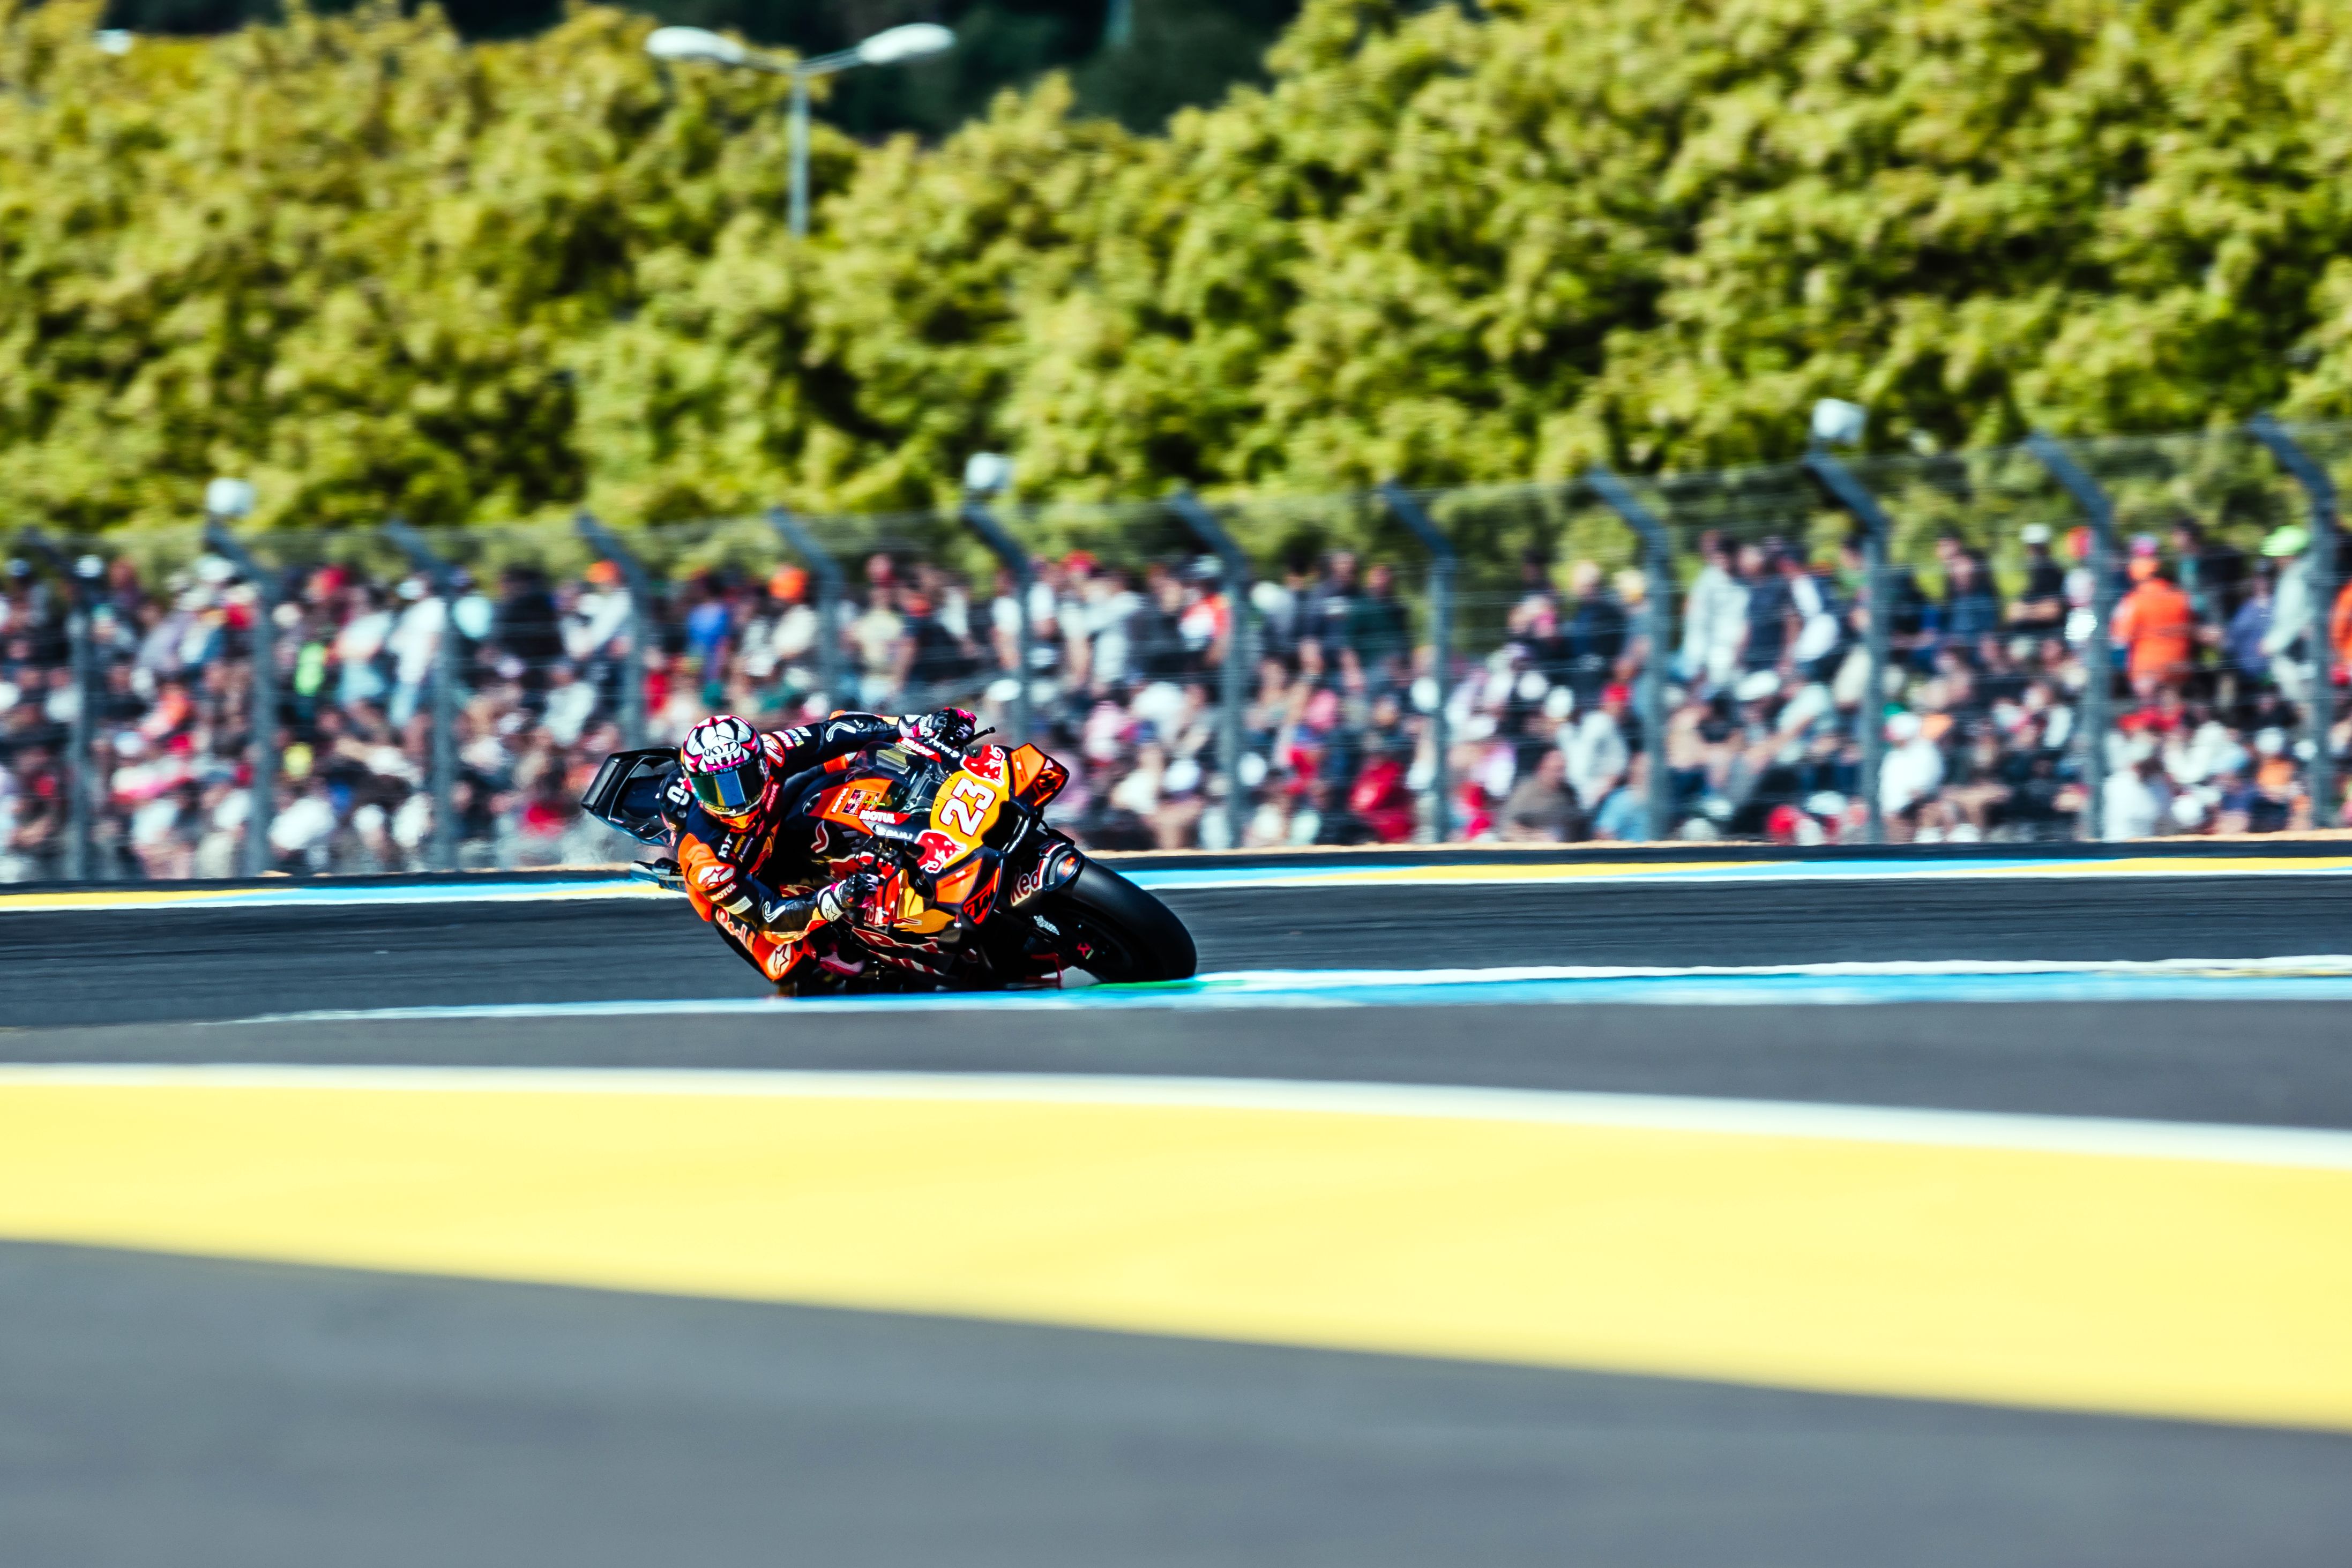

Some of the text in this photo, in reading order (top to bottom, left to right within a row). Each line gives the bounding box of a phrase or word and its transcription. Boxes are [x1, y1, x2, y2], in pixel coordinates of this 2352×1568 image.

[901, 737, 935, 756] MOTUL
[766, 783, 780, 811] MOTUL
[831, 787, 849, 812] MOTUL
[939, 778, 996, 837] 23
[858, 810, 895, 824] MOTUL
[718, 833, 733, 858] KYT
[710, 883, 737, 901] MOTUL
